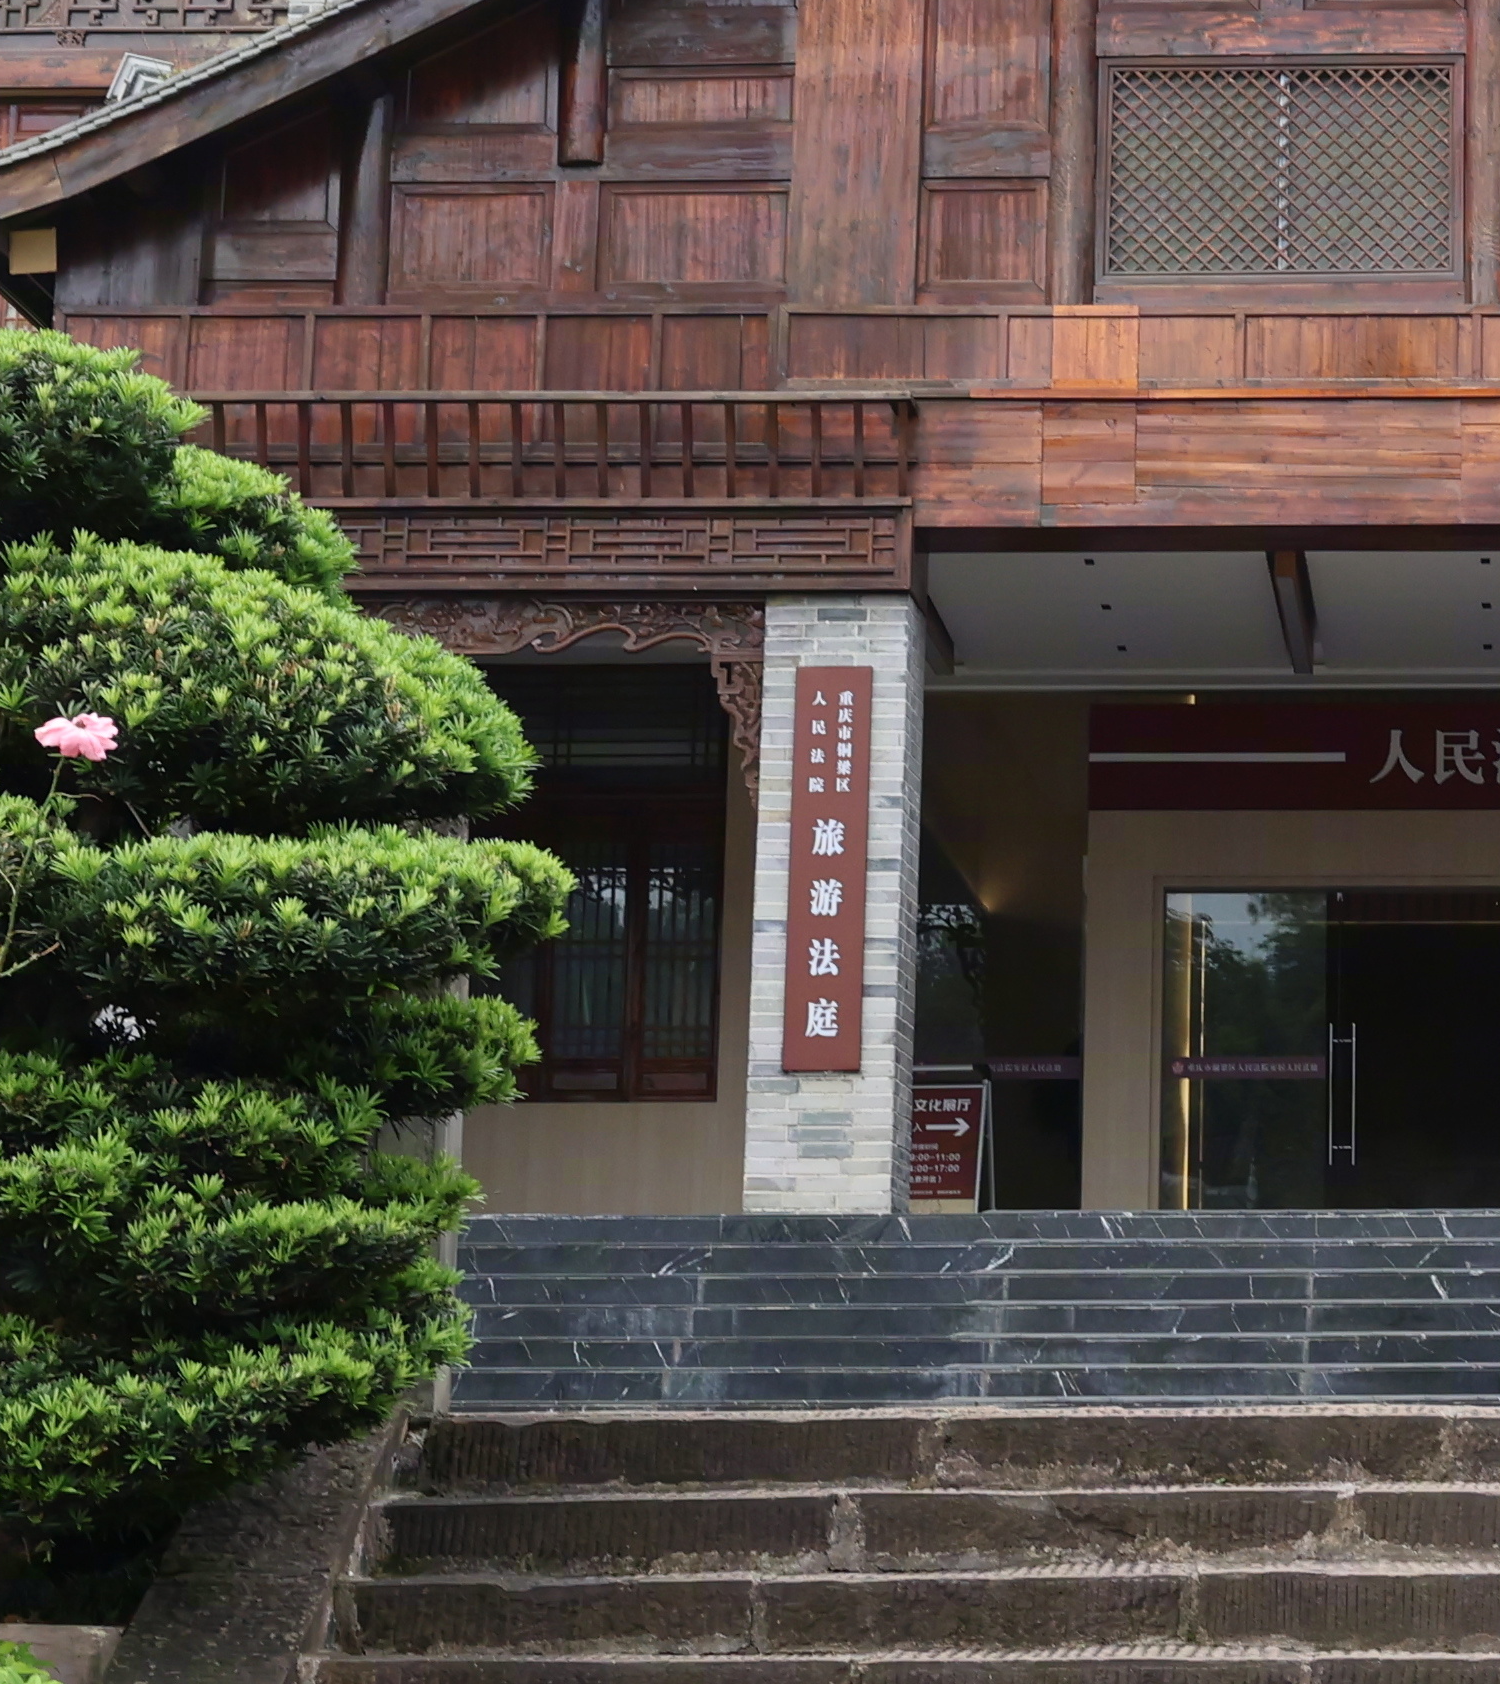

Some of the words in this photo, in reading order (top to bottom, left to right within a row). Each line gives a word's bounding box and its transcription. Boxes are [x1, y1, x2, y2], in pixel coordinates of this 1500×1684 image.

[808, 690, 828, 793] 人民法院
[835, 690, 854, 793] 重庆市铜梁区
[804, 818, 846, 1038] 旅游法庭
